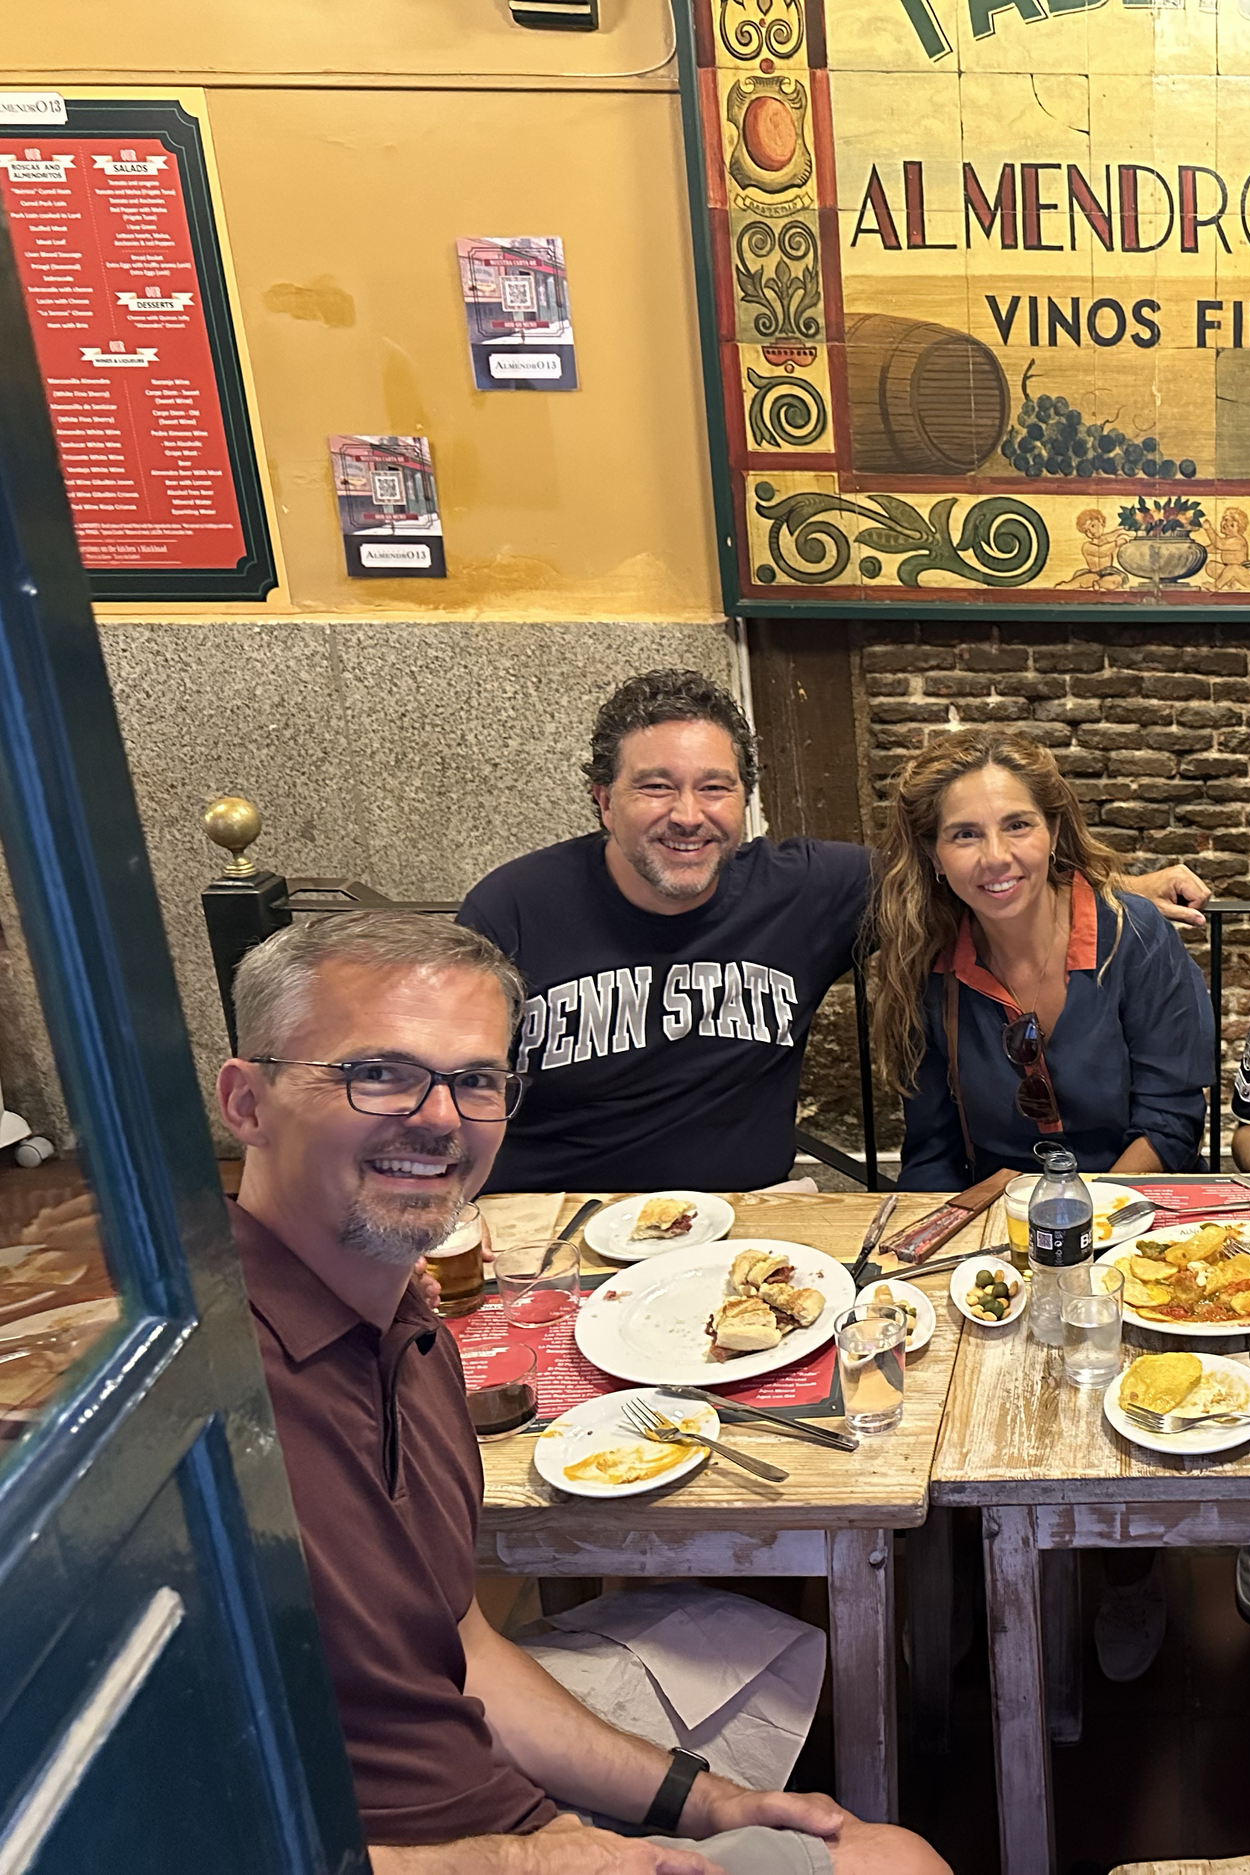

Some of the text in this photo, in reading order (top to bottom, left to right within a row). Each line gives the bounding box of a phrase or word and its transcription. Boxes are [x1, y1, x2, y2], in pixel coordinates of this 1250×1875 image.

[113, 164, 149, 172] SALADS
[136, 301, 174, 309] DESSERTS
[985, 295, 1162, 348] VINOS
[515, 961, 798, 1073] PENN STATE
